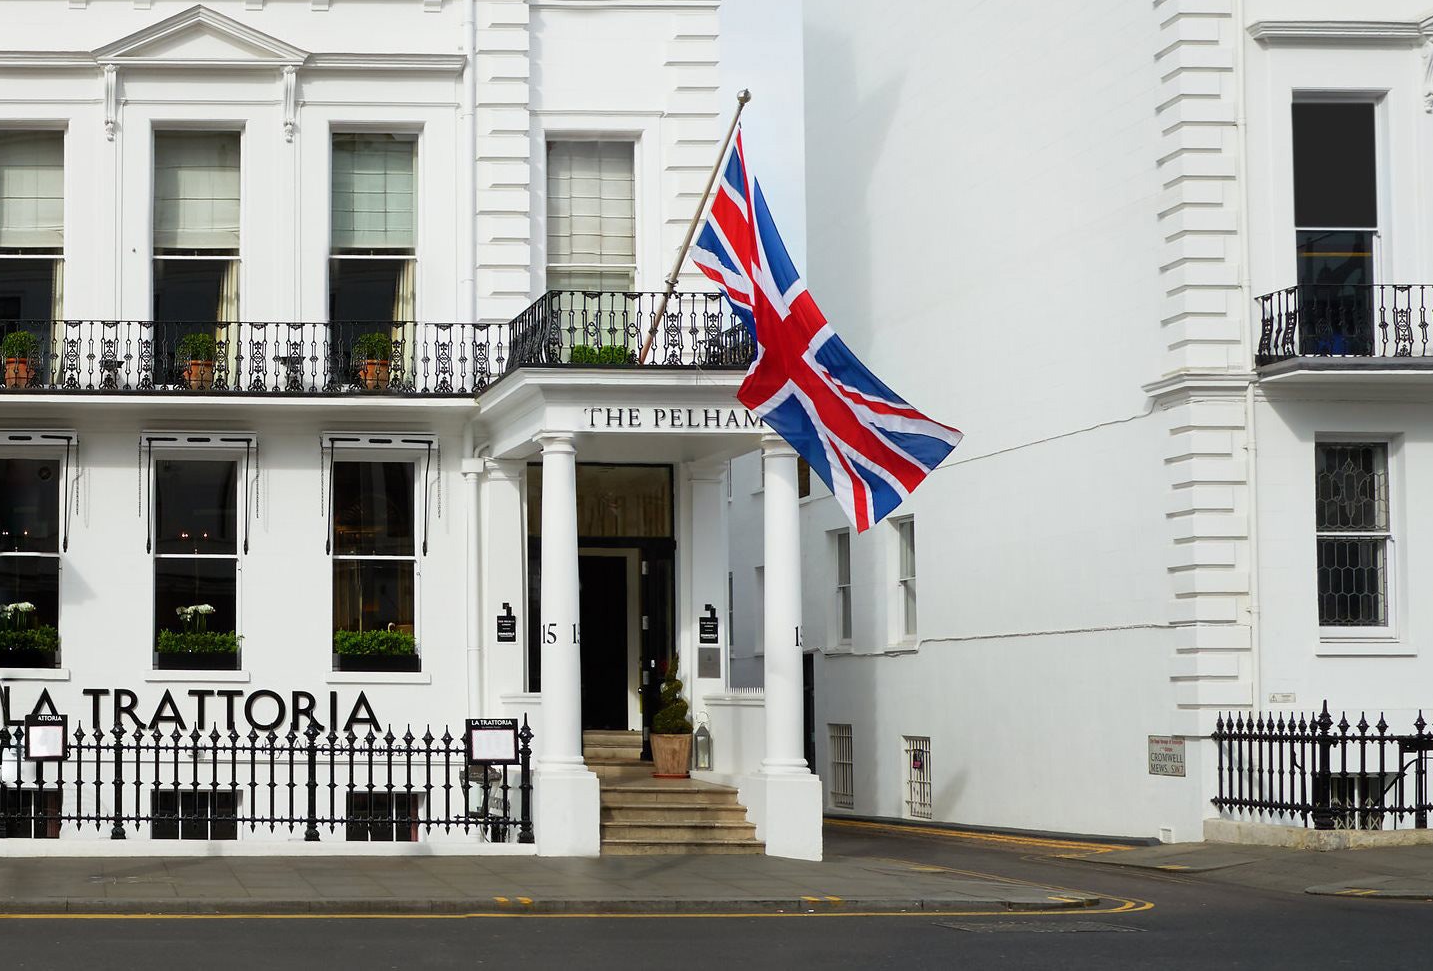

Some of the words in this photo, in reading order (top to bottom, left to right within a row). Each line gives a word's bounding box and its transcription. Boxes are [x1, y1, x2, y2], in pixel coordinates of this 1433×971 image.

[584, 408, 641, 428] THE
[653, 408, 766, 428] PELHAM
[4, 686, 59, 727] LA
[83, 688, 382, 732] TRATTORIA
[1150, 752, 1183, 763] CROMWELL
